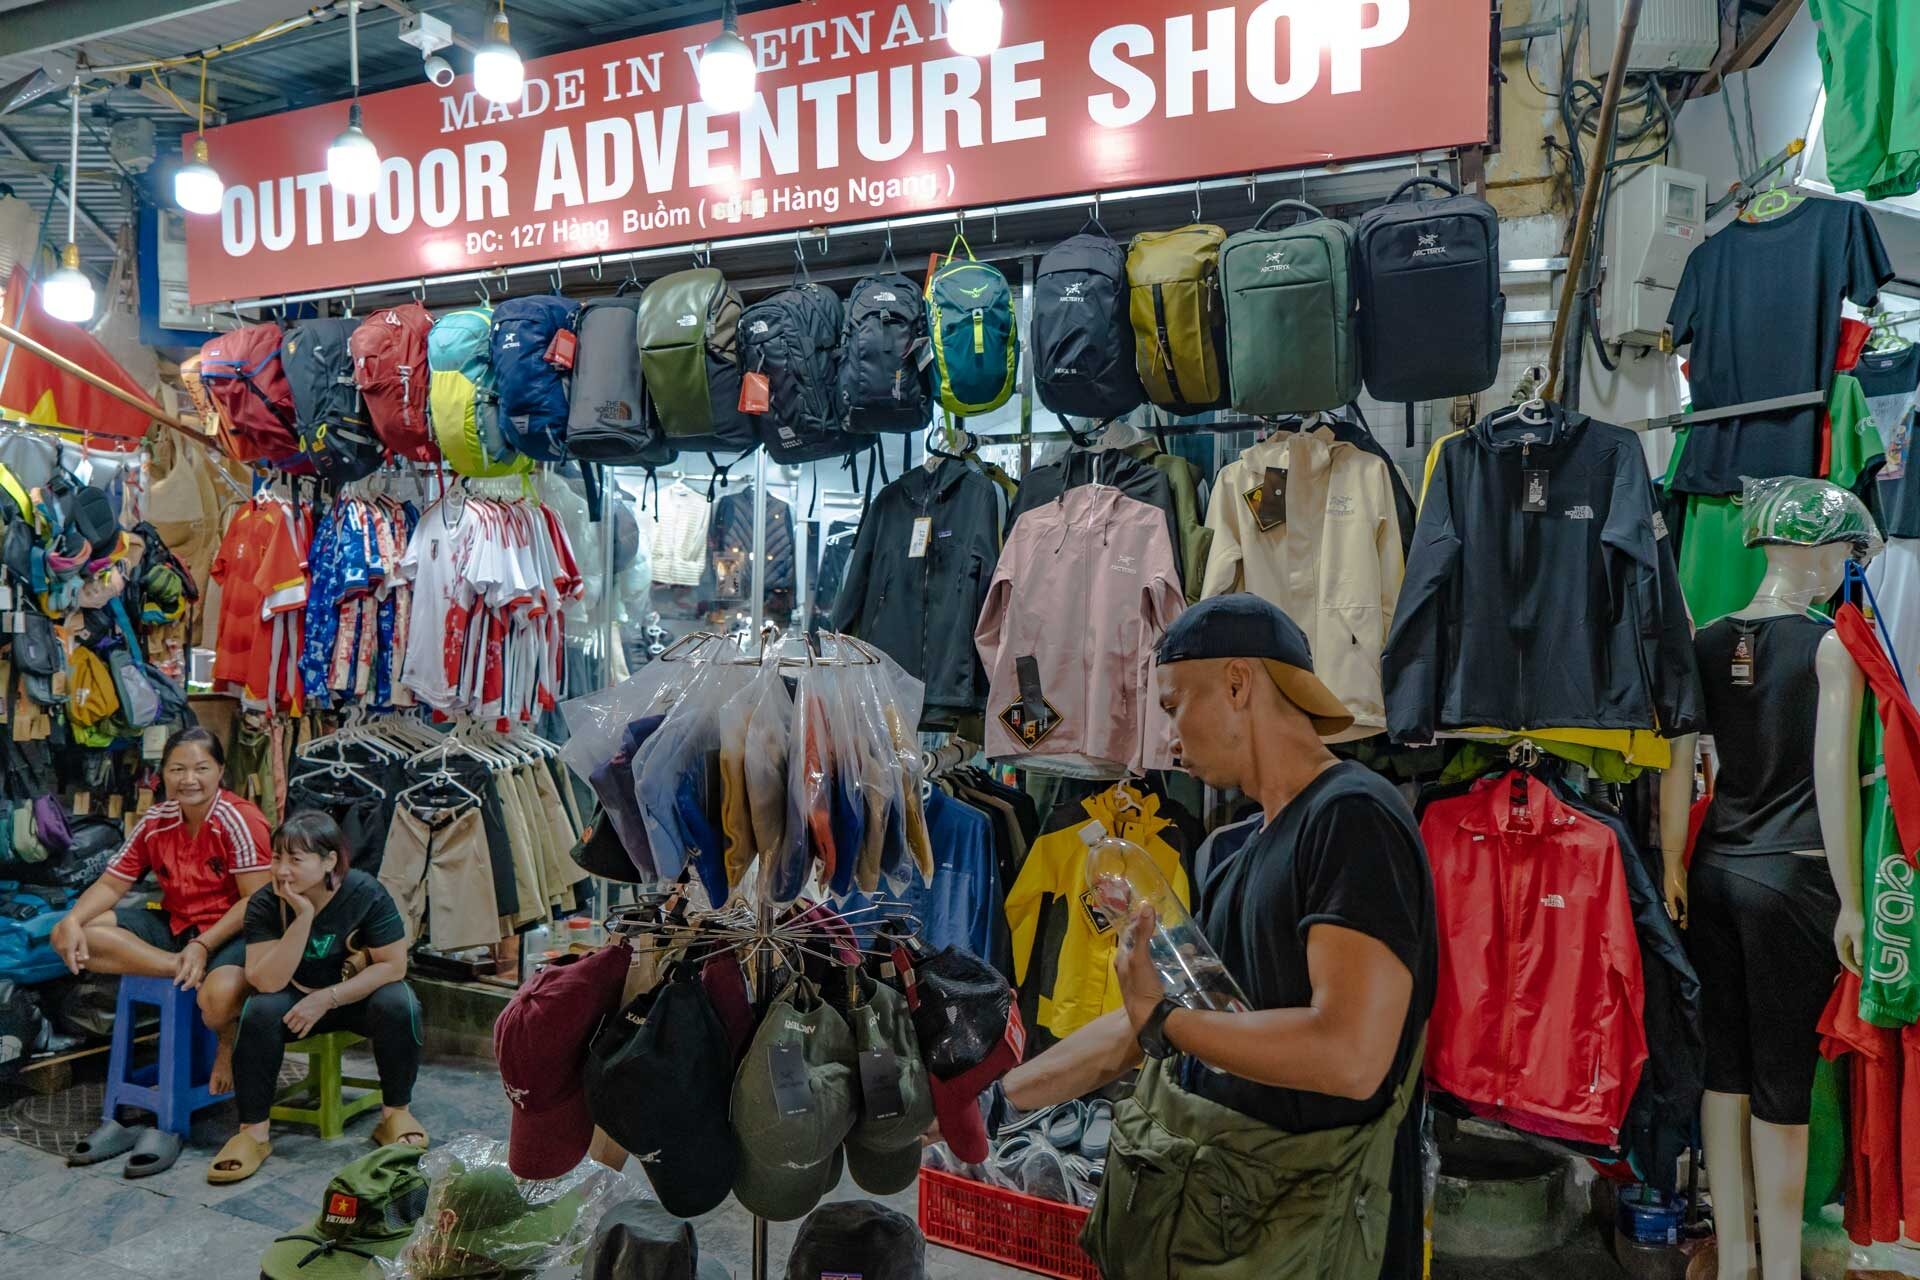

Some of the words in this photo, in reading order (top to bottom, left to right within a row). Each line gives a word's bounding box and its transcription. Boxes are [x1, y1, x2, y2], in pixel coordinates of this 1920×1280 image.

[221, 140, 510, 257] OUTDOOR
[534, 41, 1046, 212] ADVENTURE
[1088, 0, 1410, 128] SHOP
[440, 69, 585, 133] MADE
[603, 52, 664, 102] IN
[466, 230, 503, 255] ĐC:
[510, 222, 545, 249] 127
[553, 217, 608, 244] Hàng
[623, 200, 690, 233] Buồm
[773, 186, 839, 213] Hàng
[849, 173, 937, 208] Ngang
[1870, 854, 1914, 984] Grab
[326, 1213, 357, 1225] VIETNAM
